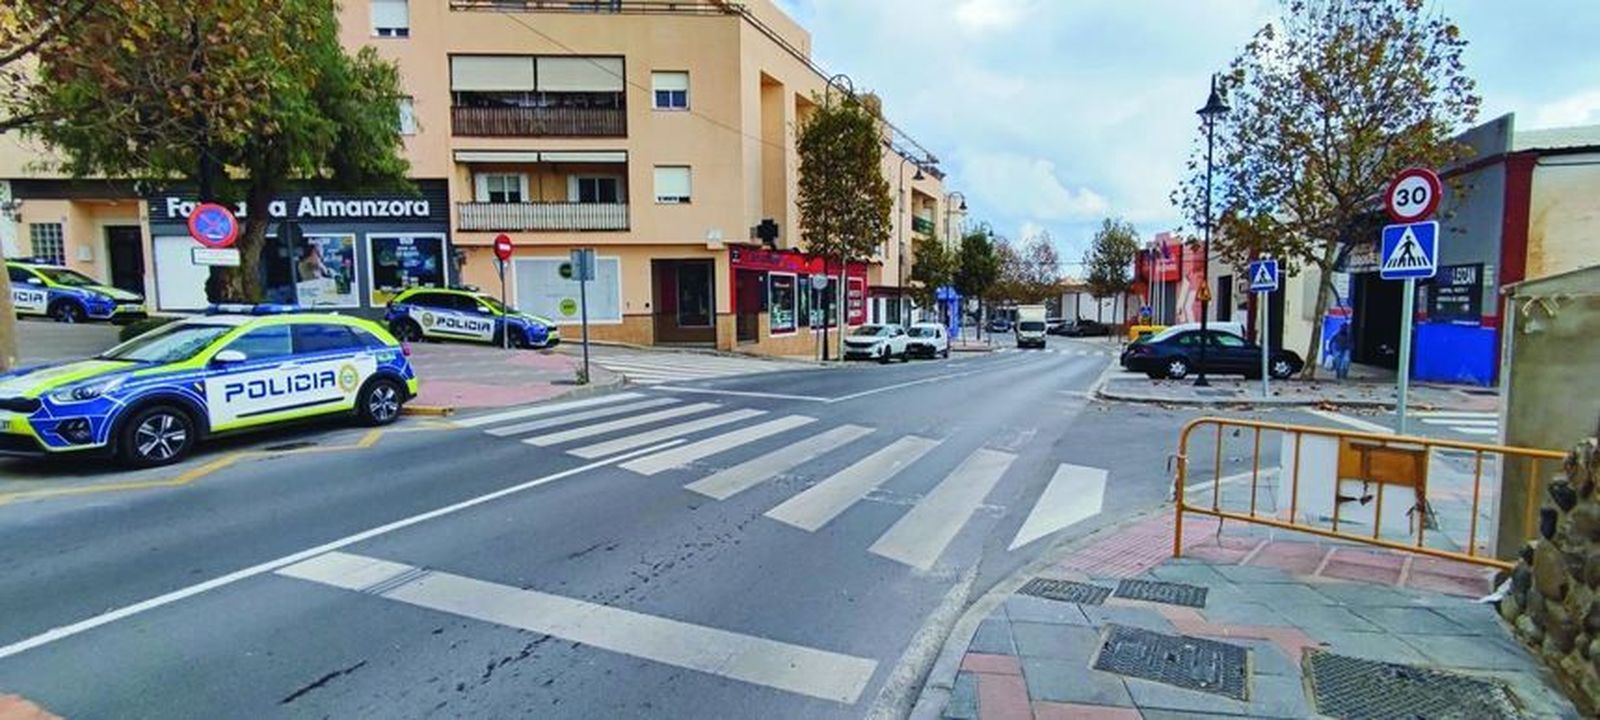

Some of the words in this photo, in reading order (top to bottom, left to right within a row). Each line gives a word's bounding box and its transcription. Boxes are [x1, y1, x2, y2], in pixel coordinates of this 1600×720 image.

[297, 196, 430, 217] Almanzora
[1396, 186, 1427, 207] 30
[436, 315, 491, 332] POLICIA
[225, 370, 336, 403] POLICIA
